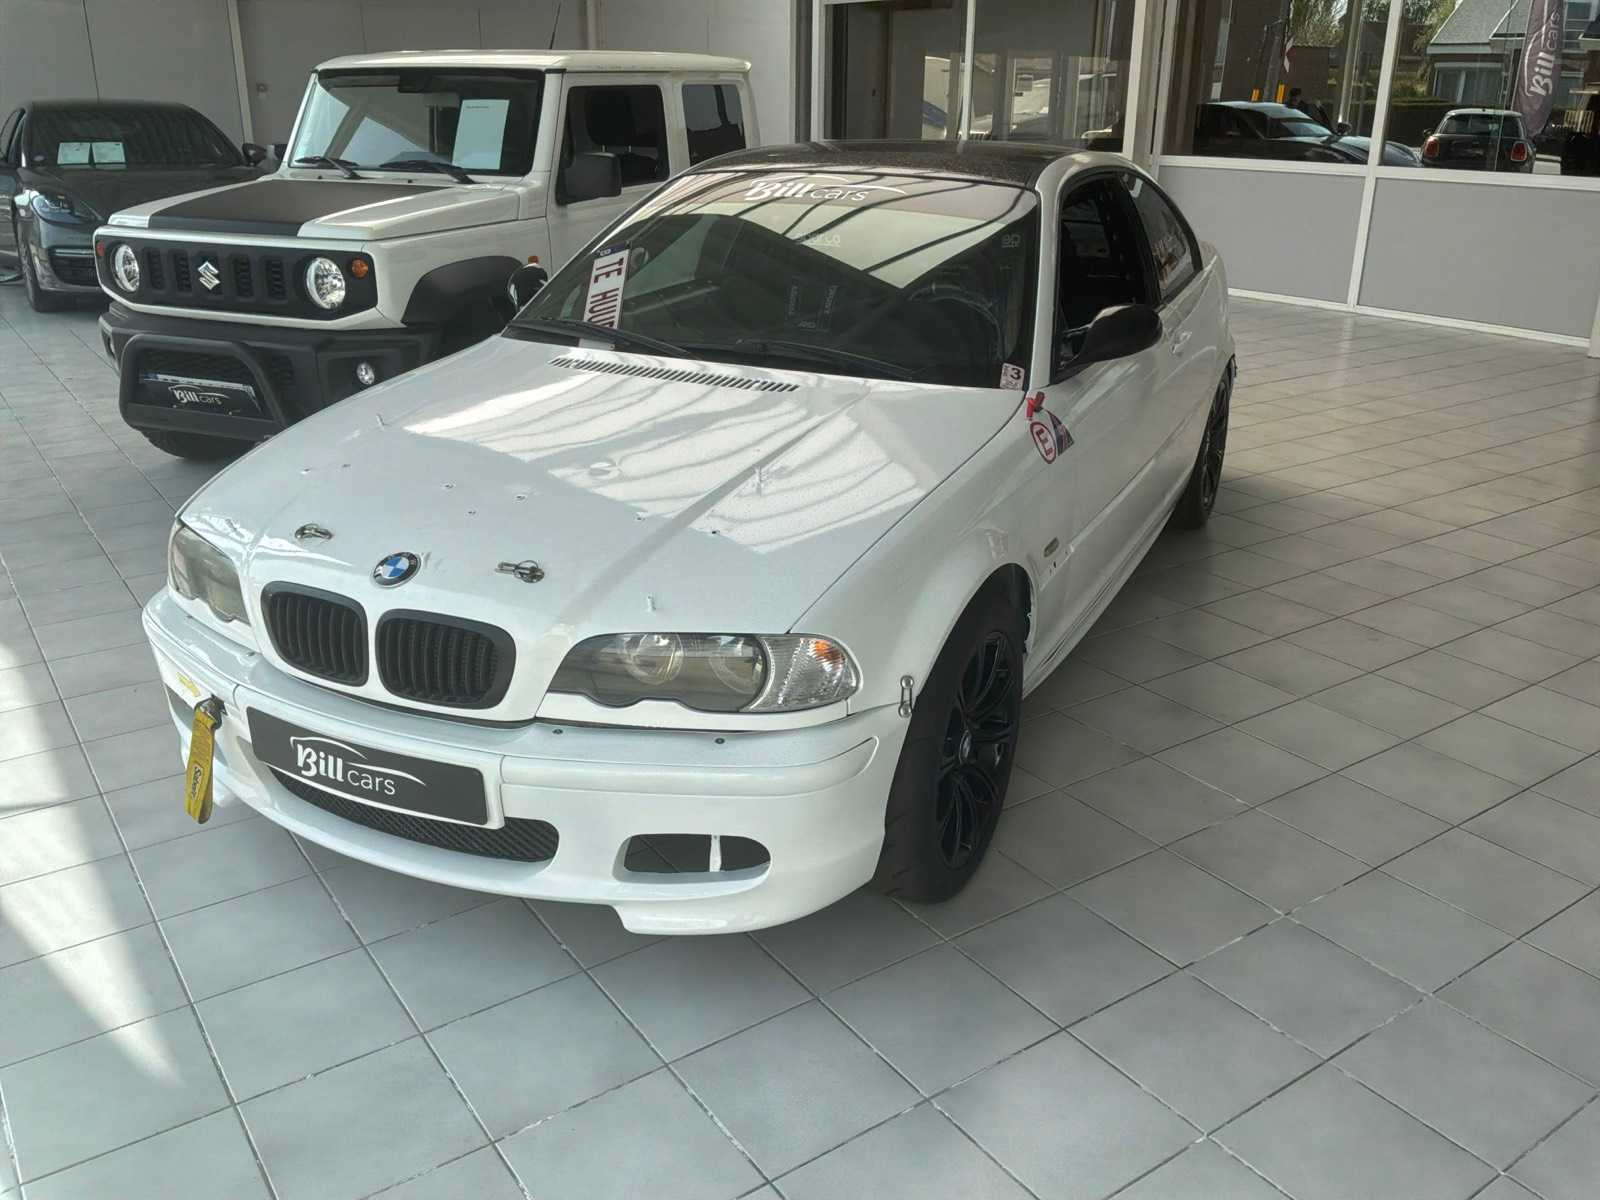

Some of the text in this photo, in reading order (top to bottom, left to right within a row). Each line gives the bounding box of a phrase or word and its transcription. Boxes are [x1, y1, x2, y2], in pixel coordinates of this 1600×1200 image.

[1530, 10, 1560, 96] Bill cars
[744, 181, 870, 201] Bill cars
[593, 256, 625, 284] TE
[1010, 367, 1022, 380] 3
[173, 389, 222, 405] Bill cars
[1035, 427, 1054, 457] E
[296, 743, 396, 795] Bill cars
